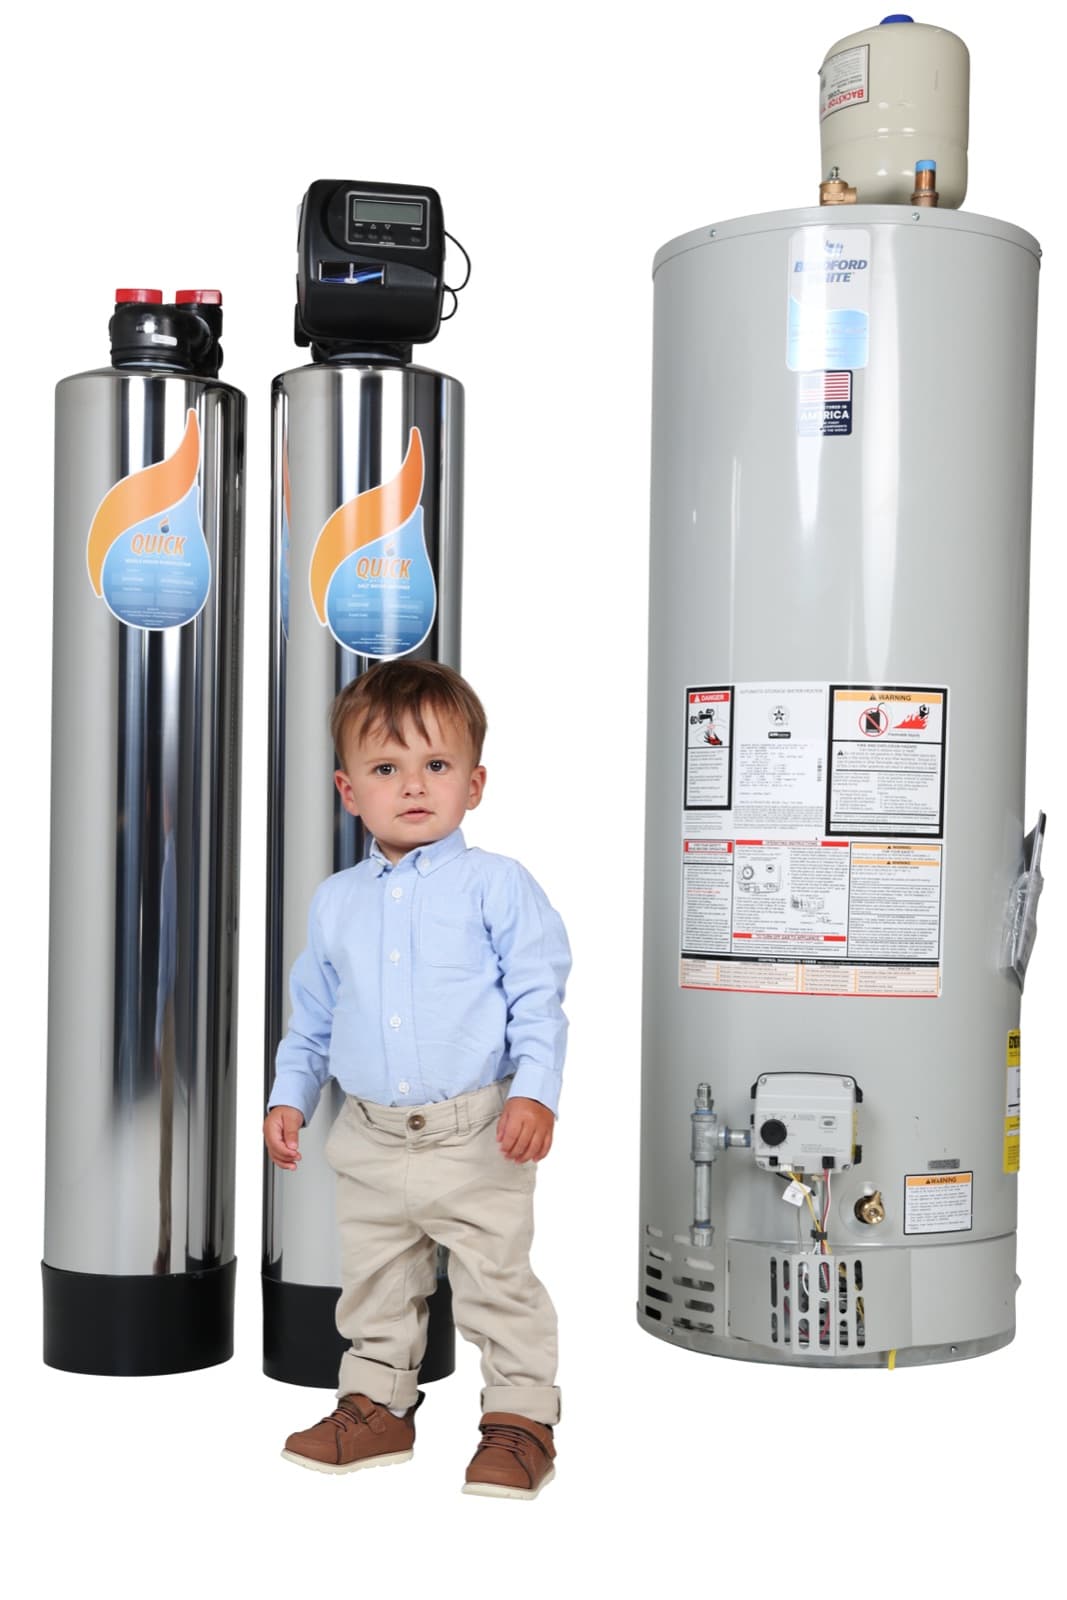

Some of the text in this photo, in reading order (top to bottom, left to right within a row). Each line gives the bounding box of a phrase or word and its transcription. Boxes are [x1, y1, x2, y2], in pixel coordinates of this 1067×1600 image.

[131, 533, 187, 556] QUICK
[356, 557, 412, 579] QUICK
[878, 694, 911, 702] WARNING
